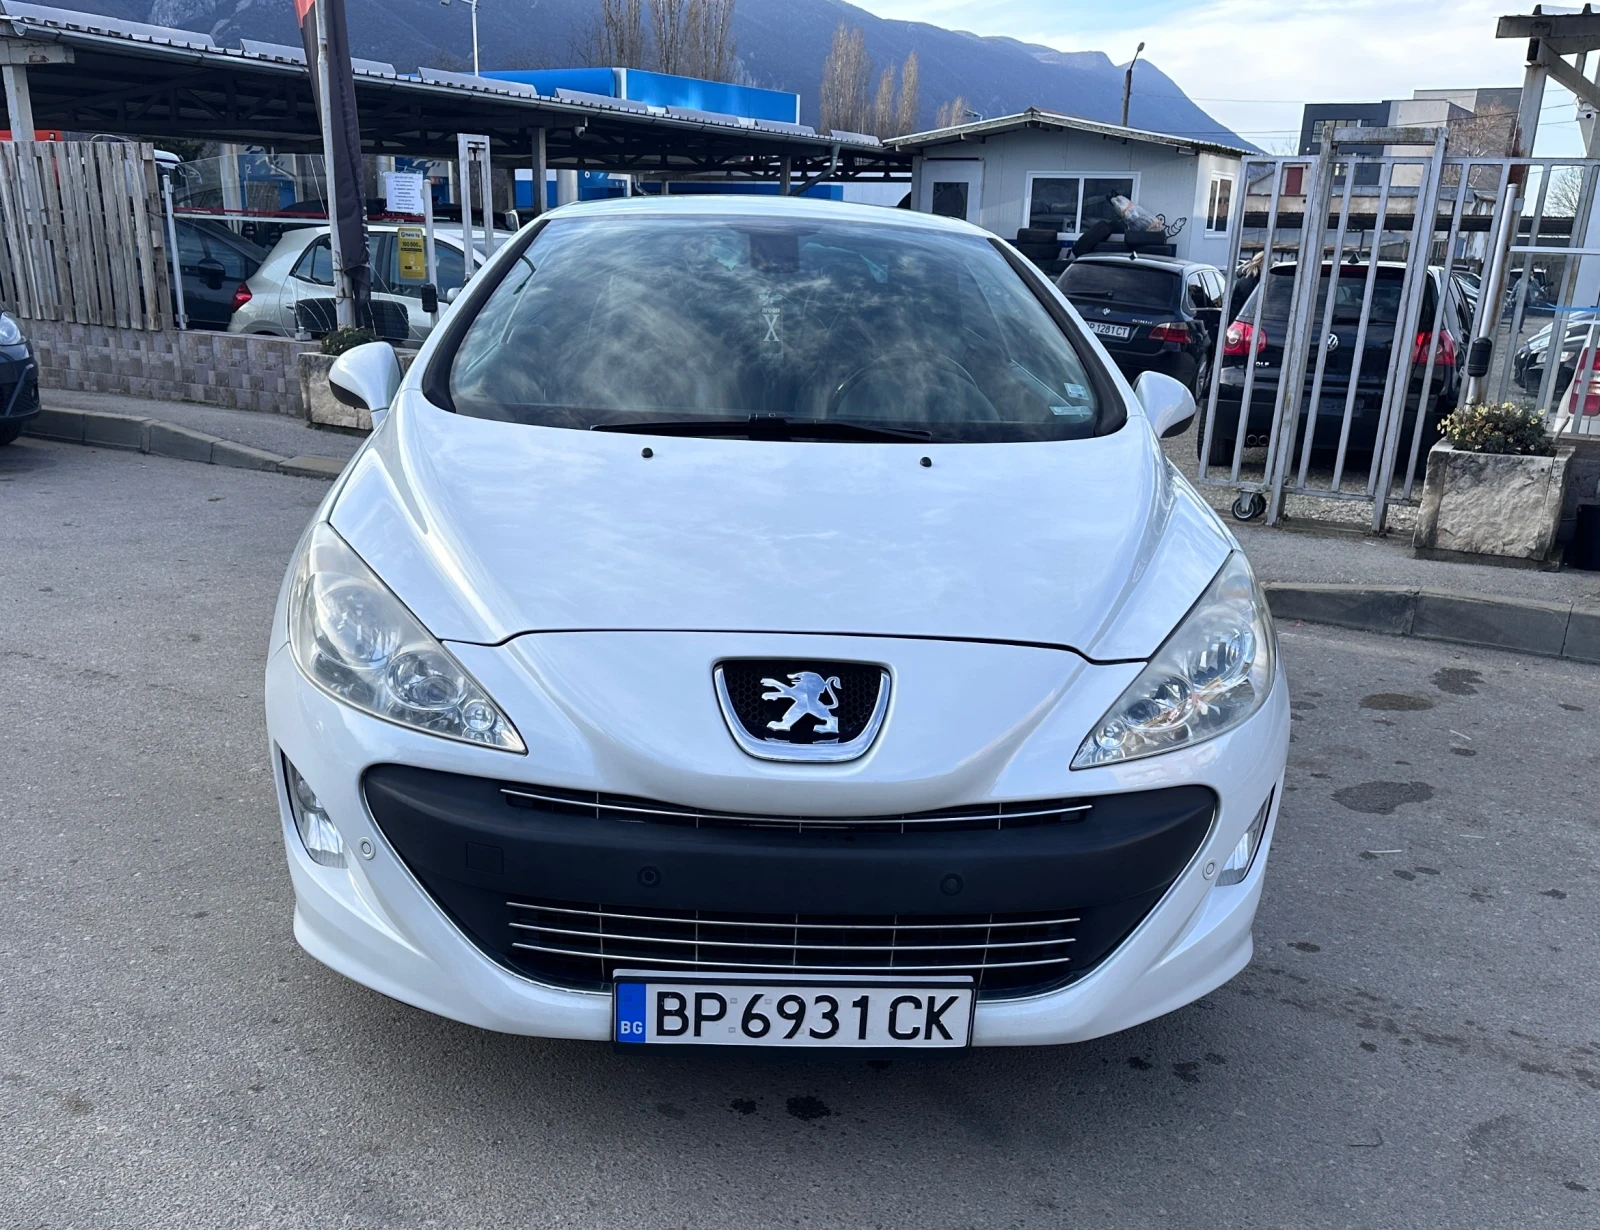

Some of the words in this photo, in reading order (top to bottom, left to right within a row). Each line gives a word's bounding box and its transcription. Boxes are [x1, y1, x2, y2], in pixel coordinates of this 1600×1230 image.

[762, 313, 781, 342] X
[1097, 324, 1115, 335] 1281
[1116, 327, 1128, 336] CT
[656, 991, 728, 1037] BP
[741, 993, 868, 1040] 6931
[888, 995, 960, 1040] CK
[620, 1020, 643, 1035] BG
